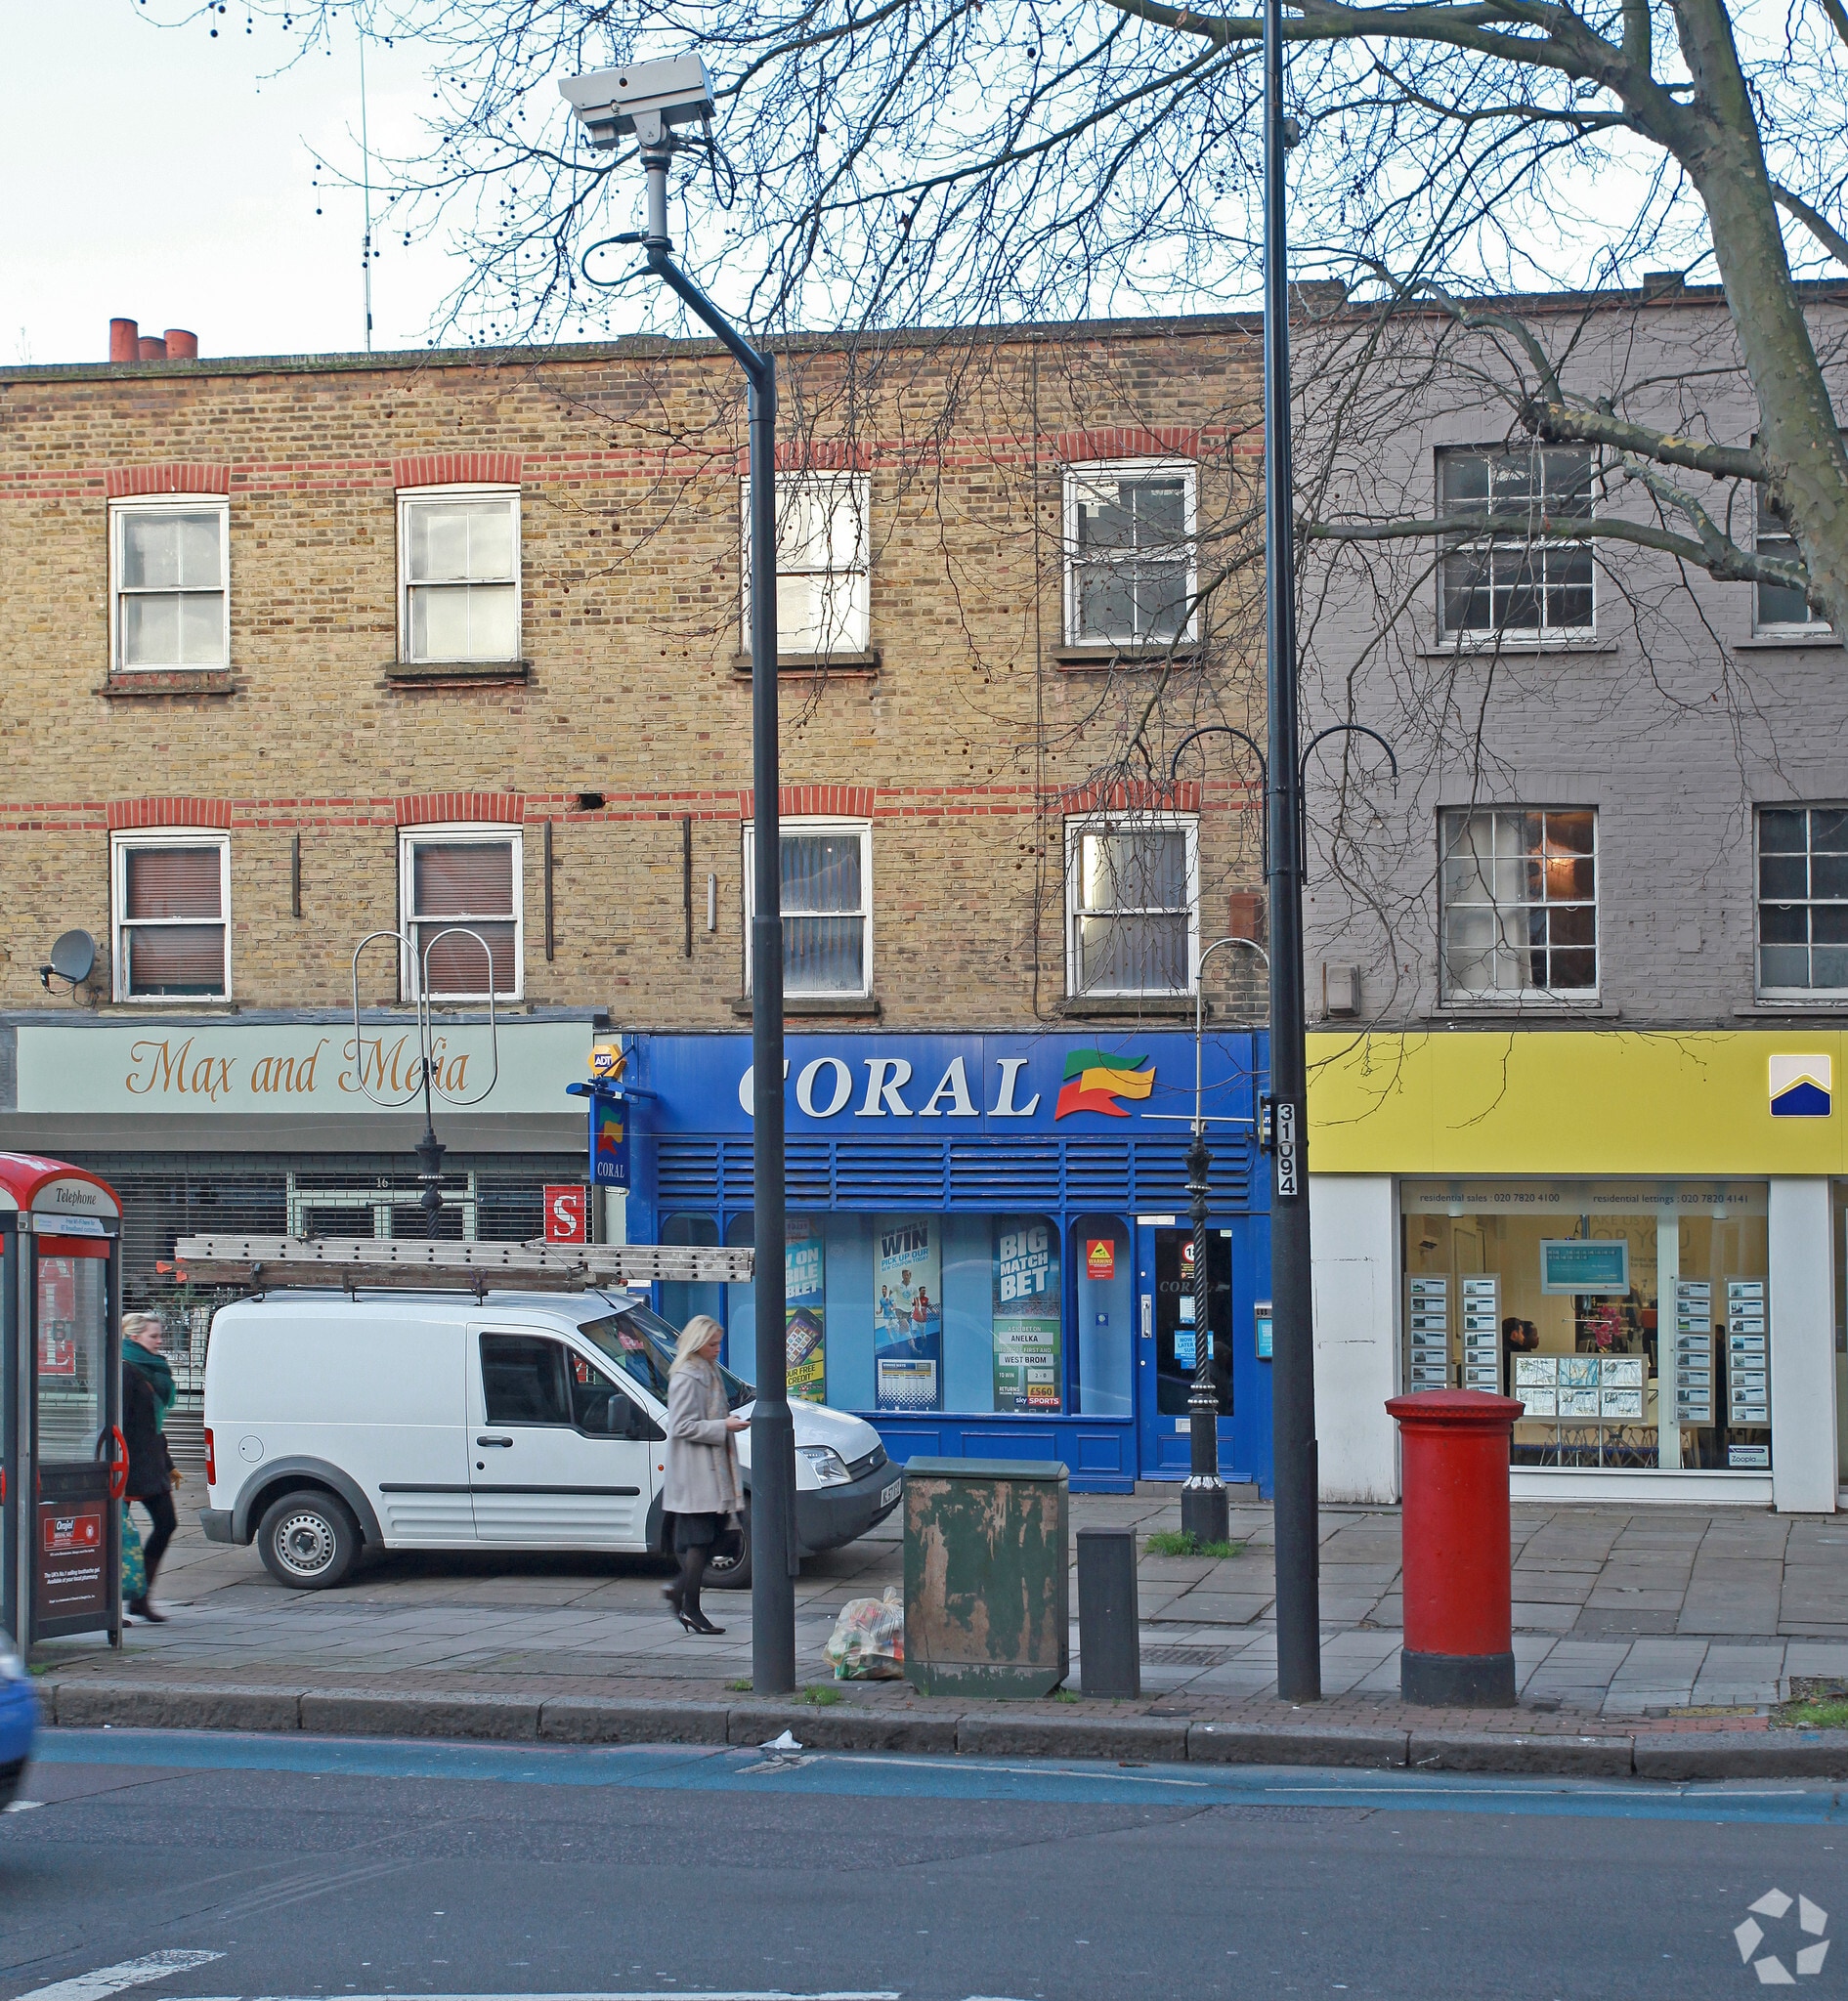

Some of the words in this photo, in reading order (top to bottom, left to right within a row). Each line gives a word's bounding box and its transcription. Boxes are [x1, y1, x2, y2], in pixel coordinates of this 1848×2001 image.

[594, 1054, 612, 1066] ADT
[125, 1036, 237, 1103] Max
[250, 1038, 331, 1093] and
[1279, 1104, 1296, 1195] 31094
[597, 1161, 625, 1178] CORAL
[375, 1176, 389, 1188] 16
[56, 1187, 97, 1207] Telephone
[1420, 1193, 1465, 1203] residential
[1467, 1193, 1487, 1203] sales
[1494, 1193, 1511, 1203] 020
[1514, 1193, 1535, 1203] 7820
[1537, 1193, 1560, 1203] 4100
[1593, 1194, 1640, 1204] residential
[1642, 1194, 1675, 1206] lettings
[1681, 1194, 1698, 1204] 020
[1702, 1194, 1725, 1204] 7820
[1727, 1194, 1748, 1204] 4141
[1591, 1214, 1618, 1226] AKE
[881, 1227, 928, 1258] WIN
[1000, 1225, 1049, 1263] BIG
[795, 1247, 819, 1265] ON
[881, 1256, 897, 1267] PICK
[898, 1253, 910, 1261] UP
[911, 1248, 929, 1258] OUR
[1000, 1252, 1049, 1277] MATCH
[785, 1263, 818, 1285] BILE
[785, 1280, 818, 1299] BLET
[1001, 1265, 1049, 1302] BET
[786, 1368, 798, 1378] OUR
[799, 1364, 816, 1374] FREE
[1015, 1396, 1027, 1405] sky
[1030, 1387, 1053, 1396] £560
